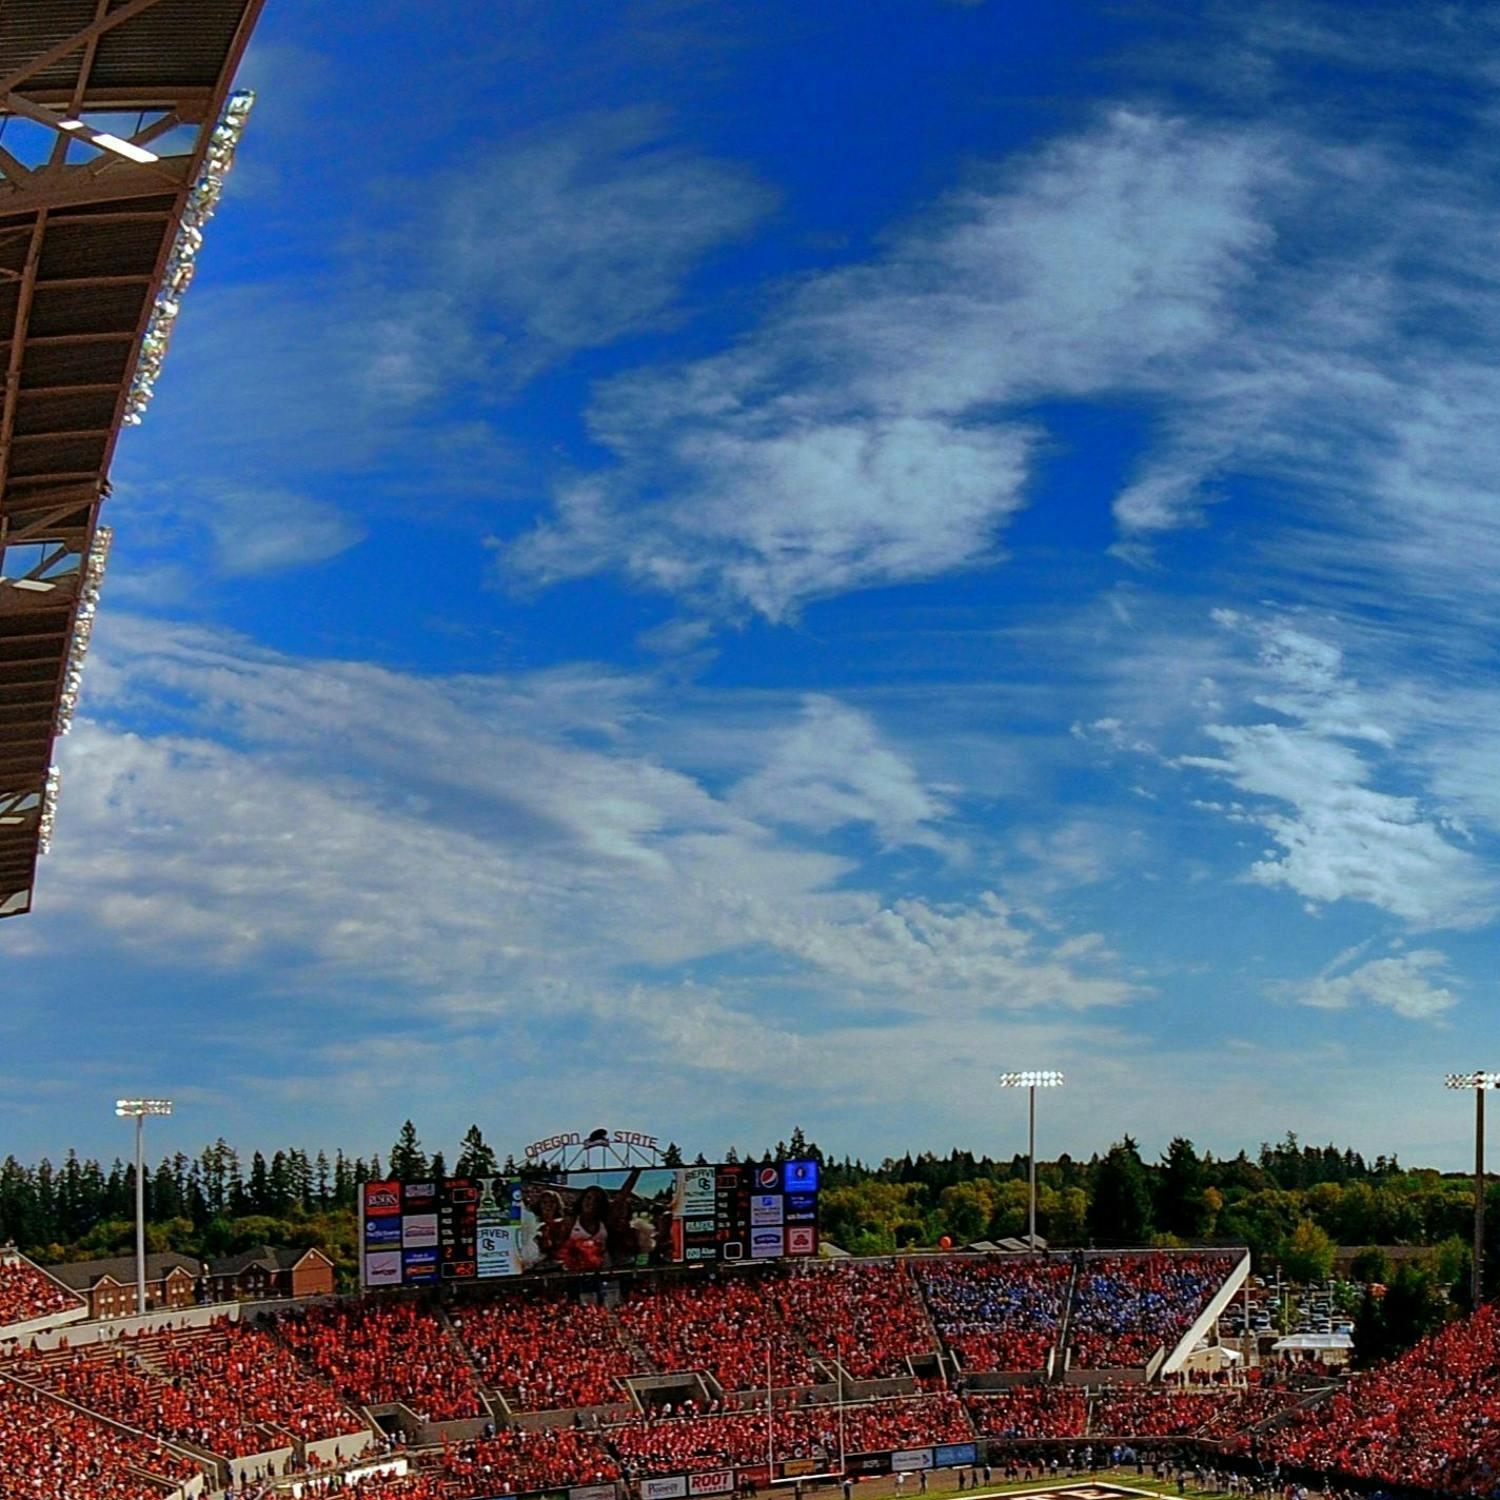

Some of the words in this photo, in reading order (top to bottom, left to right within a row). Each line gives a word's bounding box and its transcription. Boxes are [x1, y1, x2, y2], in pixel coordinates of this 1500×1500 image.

[525, 1132, 580, 1158] OREGON
[614, 1130, 658, 1148] STATE
[691, 1473, 731, 1489] ROOT
